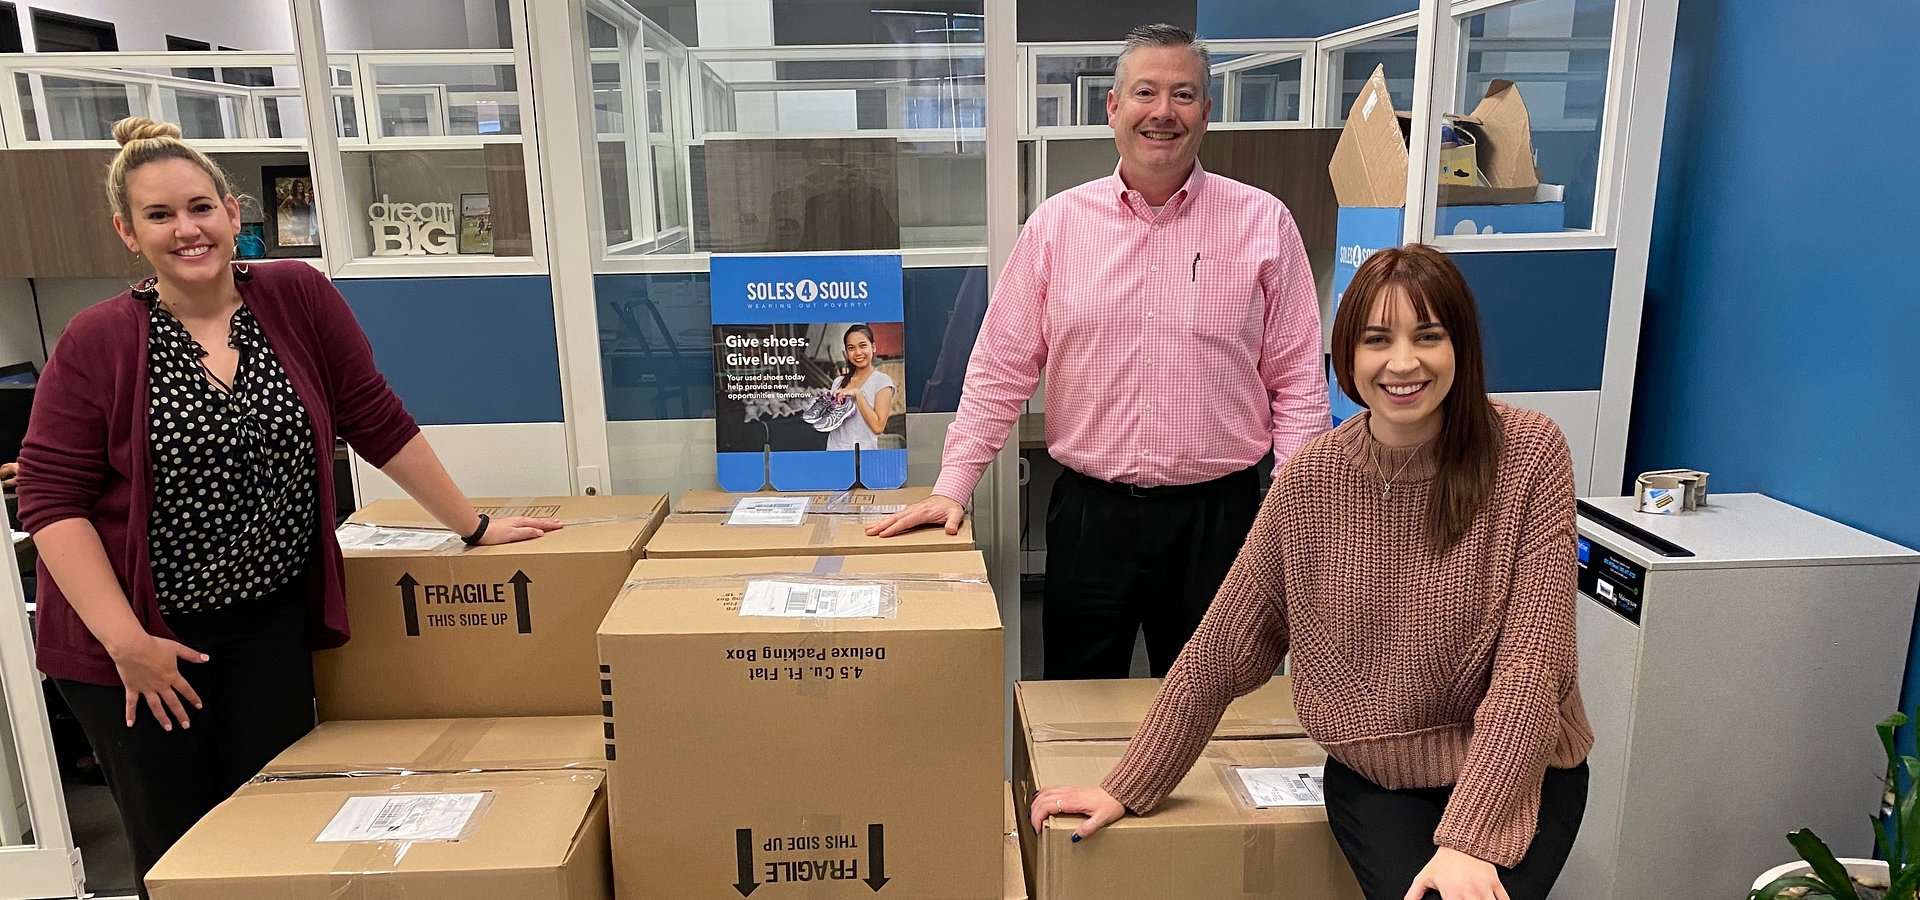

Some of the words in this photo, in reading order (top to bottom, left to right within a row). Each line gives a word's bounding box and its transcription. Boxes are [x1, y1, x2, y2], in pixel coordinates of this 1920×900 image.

[369, 194, 453, 223] dream
[370, 220, 458, 256] BIG
[746, 282, 795, 300] SOLES
[819, 281, 868, 300] SOULS
[725, 334, 759, 348] Give
[762, 334, 809, 348] shoes.
[726, 353, 760, 366] Give
[764, 352, 799, 365] love.
[785, 373, 805, 382] today
[727, 383, 743, 391] help
[744, 383, 772, 391] provide
[727, 392, 775, 400] opportunities
[424, 583, 506, 604] FRAGILE
[427, 614, 455, 626] THIS
[460, 613, 488, 626] SIDE
[491, 613, 508, 625] UP
[726, 649, 756, 661] Box
[763, 646, 826, 661] Packing
[831, 647, 886, 660] Deluxe
[749, 667, 778, 680] Flat
[784, 667, 802, 680] Ft.
[809, 666, 834, 679] Cu.
[840, 666, 863, 679] 4.5
[763, 837, 782, 851] UP
[788, 836, 819, 850] SIDE
[825, 834, 858, 848] THIS
[765, 859, 857, 883] FRAGILE
